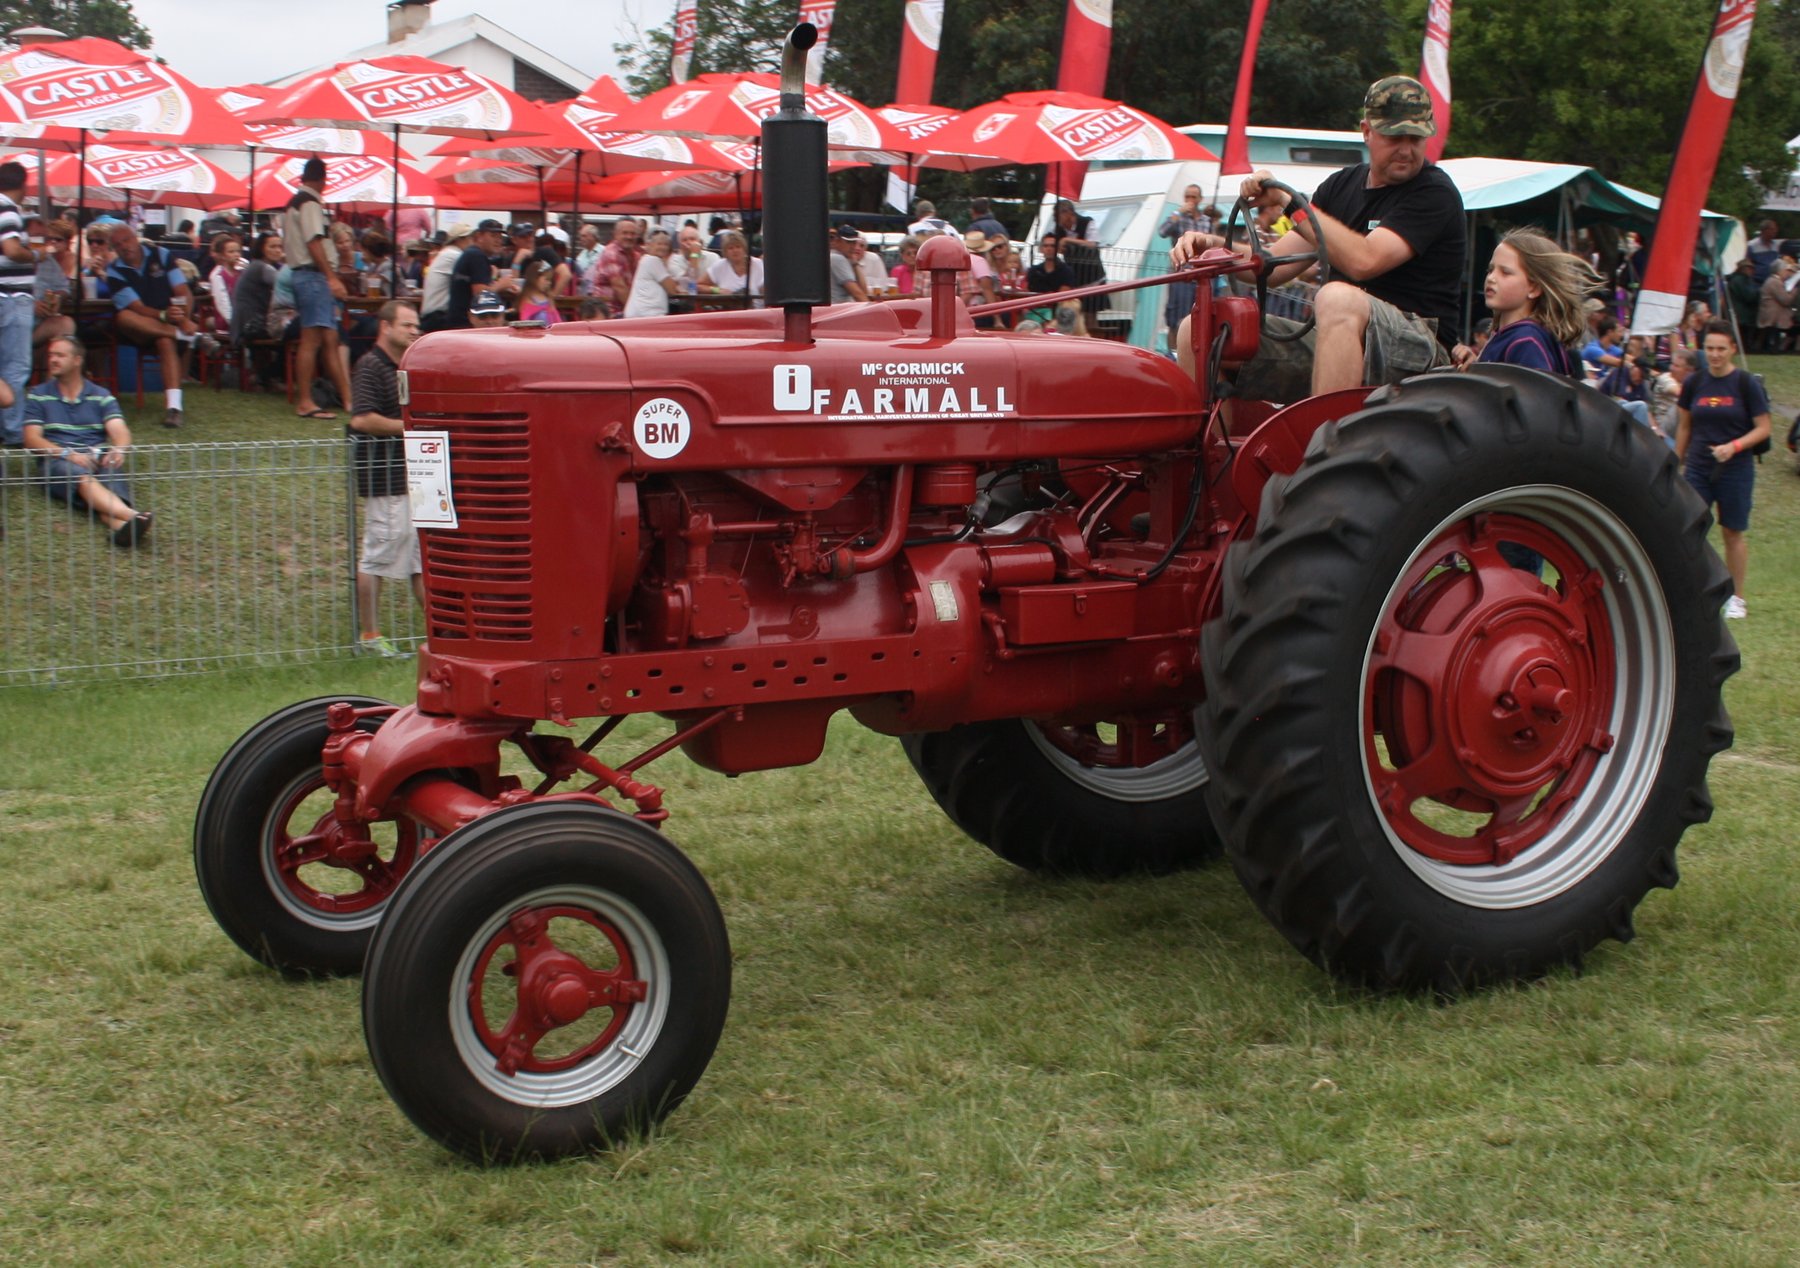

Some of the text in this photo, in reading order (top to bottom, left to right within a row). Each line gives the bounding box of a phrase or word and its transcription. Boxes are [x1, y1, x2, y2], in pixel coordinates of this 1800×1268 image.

[22, 70, 153, 105] CASTLE
[362, 73, 471, 107] CASTLE
[76, 93, 122, 108] LAGER
[410, 97, 449, 110] LAGER
[1063, 110, 1133, 147] CASTLE
[100, 153, 185, 176] CASTLE
[325, 160, 375, 186] STLE
[885, 362, 965, 376] CORMICK
[879, 376, 950, 386] INTERNATIONAL
[642, 403, 682, 419] SUPER
[813, 387, 1014, 415] FARMALL
[644, 423, 679, 444] BM
[420, 442, 441, 454] car
